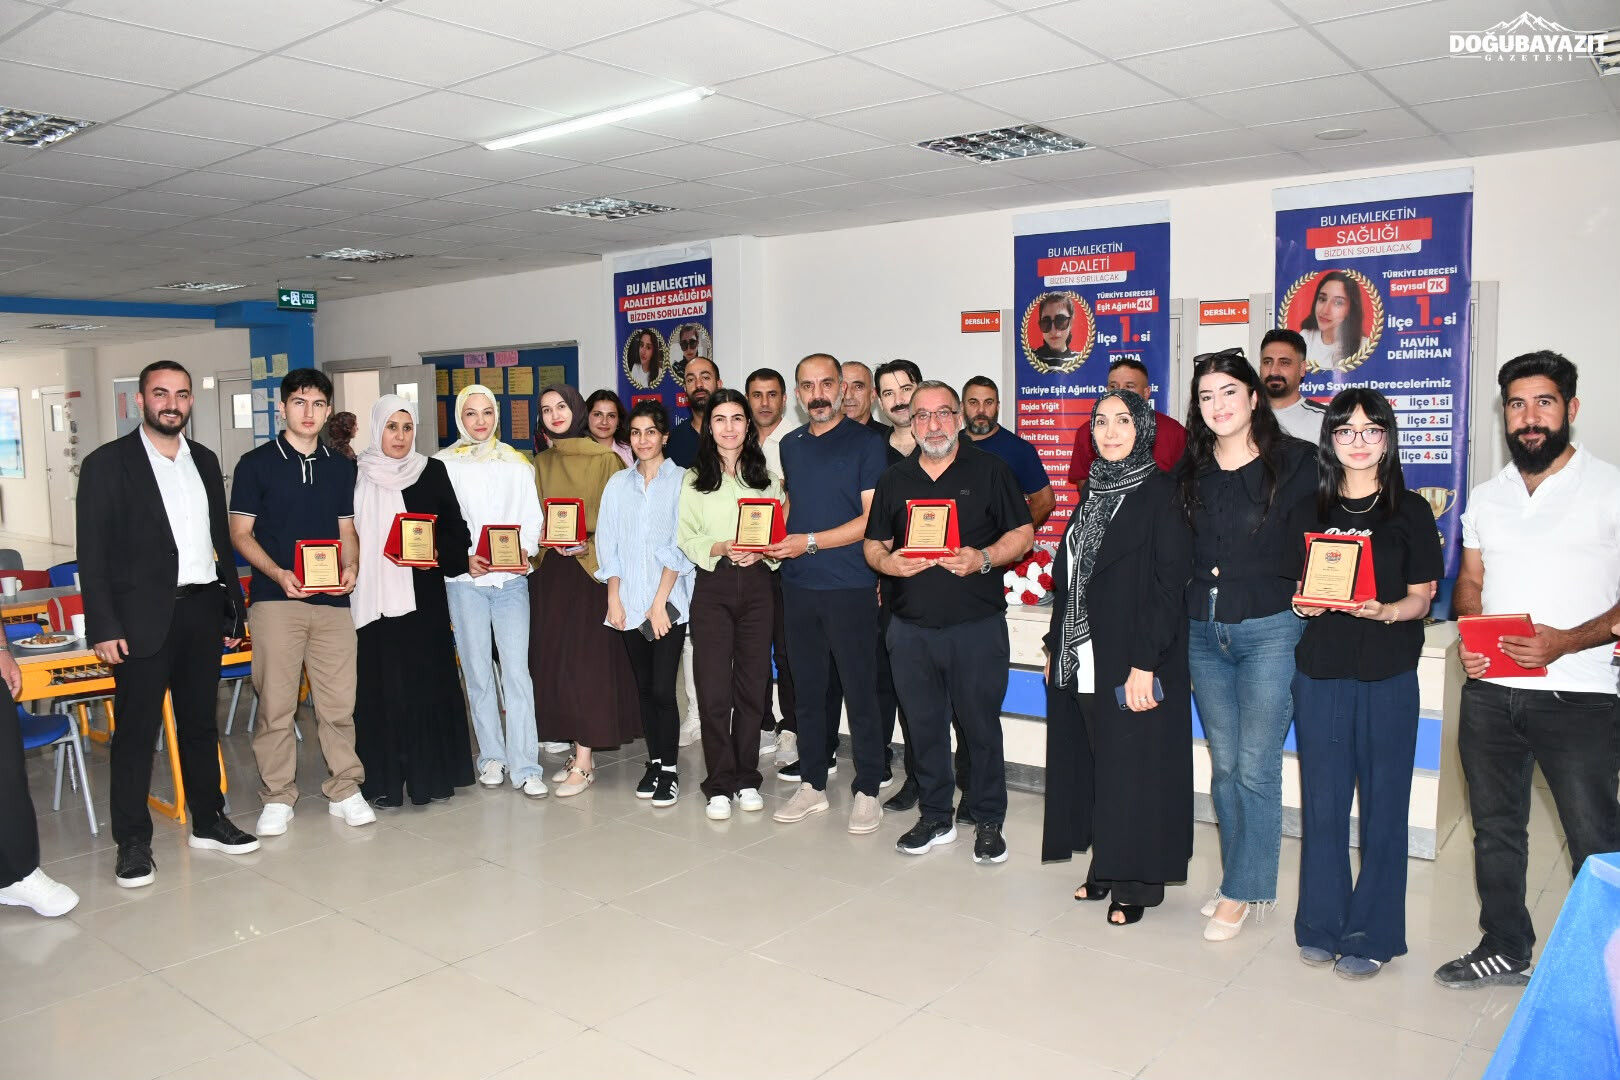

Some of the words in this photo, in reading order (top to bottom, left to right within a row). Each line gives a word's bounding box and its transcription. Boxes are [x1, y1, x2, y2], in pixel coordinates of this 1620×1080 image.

[1320, 216, 1337, 227] BU
[1340, 207, 1416, 224] MEMLEKETİN
[1336, 224, 1399, 244] SAĞLIĞI
[1048, 248, 1060, 257] BU
[1063, 242, 1123, 256] MEMLEKETİN
[1356, 242, 1412, 255] SORULACAK
[1060, 256, 1110, 273] ADALETİ
[1076, 273, 1120, 283] SORULACAK
[1382, 269, 1416, 279] TÜRKİYE
[1418, 266, 1458, 277] DERECESİ
[627, 285, 639, 295] BU
[641, 273, 706, 291] MEMLEKETİN
[1391, 282, 1426, 294] Sayısal
[1430, 280, 1443, 290] 7K
[624, 296, 655, 309] ADALETİ
[656, 296, 666, 305] DE
[668, 289, 700, 303] SAĞLIĞI
[701, 289, 712, 299] DA
[1097, 290, 1124, 298] TÜRKİYE
[1125, 289, 1156, 297] DERECESİ
[1097, 303, 1111, 312] Eşit
[1112, 302, 1137, 311] Ağırlık
[1138, 300, 1151, 309] 4K
[1203, 307, 1236, 316] DERSLİK
[630, 311, 656, 322] BİZDEN
[657, 305, 704, 319] SORULACAK
[965, 317, 990, 325] DERSLİK
[1388, 314, 1413, 331] İlçe
[1097, 331, 1117, 346] İlçe
[1400, 335, 1439, 347] HAVİN
[1388, 348, 1452, 360] DEMİRHAN
[1021, 386, 1049, 395] Türkiye
[1050, 386, 1066, 395] Eşit
[1068, 385, 1096, 395] Ağırlık
[1298, 382, 1324, 394] rkiye
[1370, 378, 1451, 389] Derecelerimiz
[1041, 402, 1059, 412] Yiğit
[1409, 396, 1430, 409] İlçe
[1432, 396, 1449, 406] 1.si
[1407, 414, 1427, 427] İlçe
[1429, 414, 1449, 425] 2.si
[1037, 434, 1060, 443] Erkuş
[1403, 431, 1423, 444] İlçe
[1425, 433, 1448, 443] 3.sü
[1401, 449, 1421, 462] İlçe
[1423, 451, 1448, 461] 4.sü
[1042, 463, 1070, 471] Demirh
[1055, 493, 1068, 502] ürk
